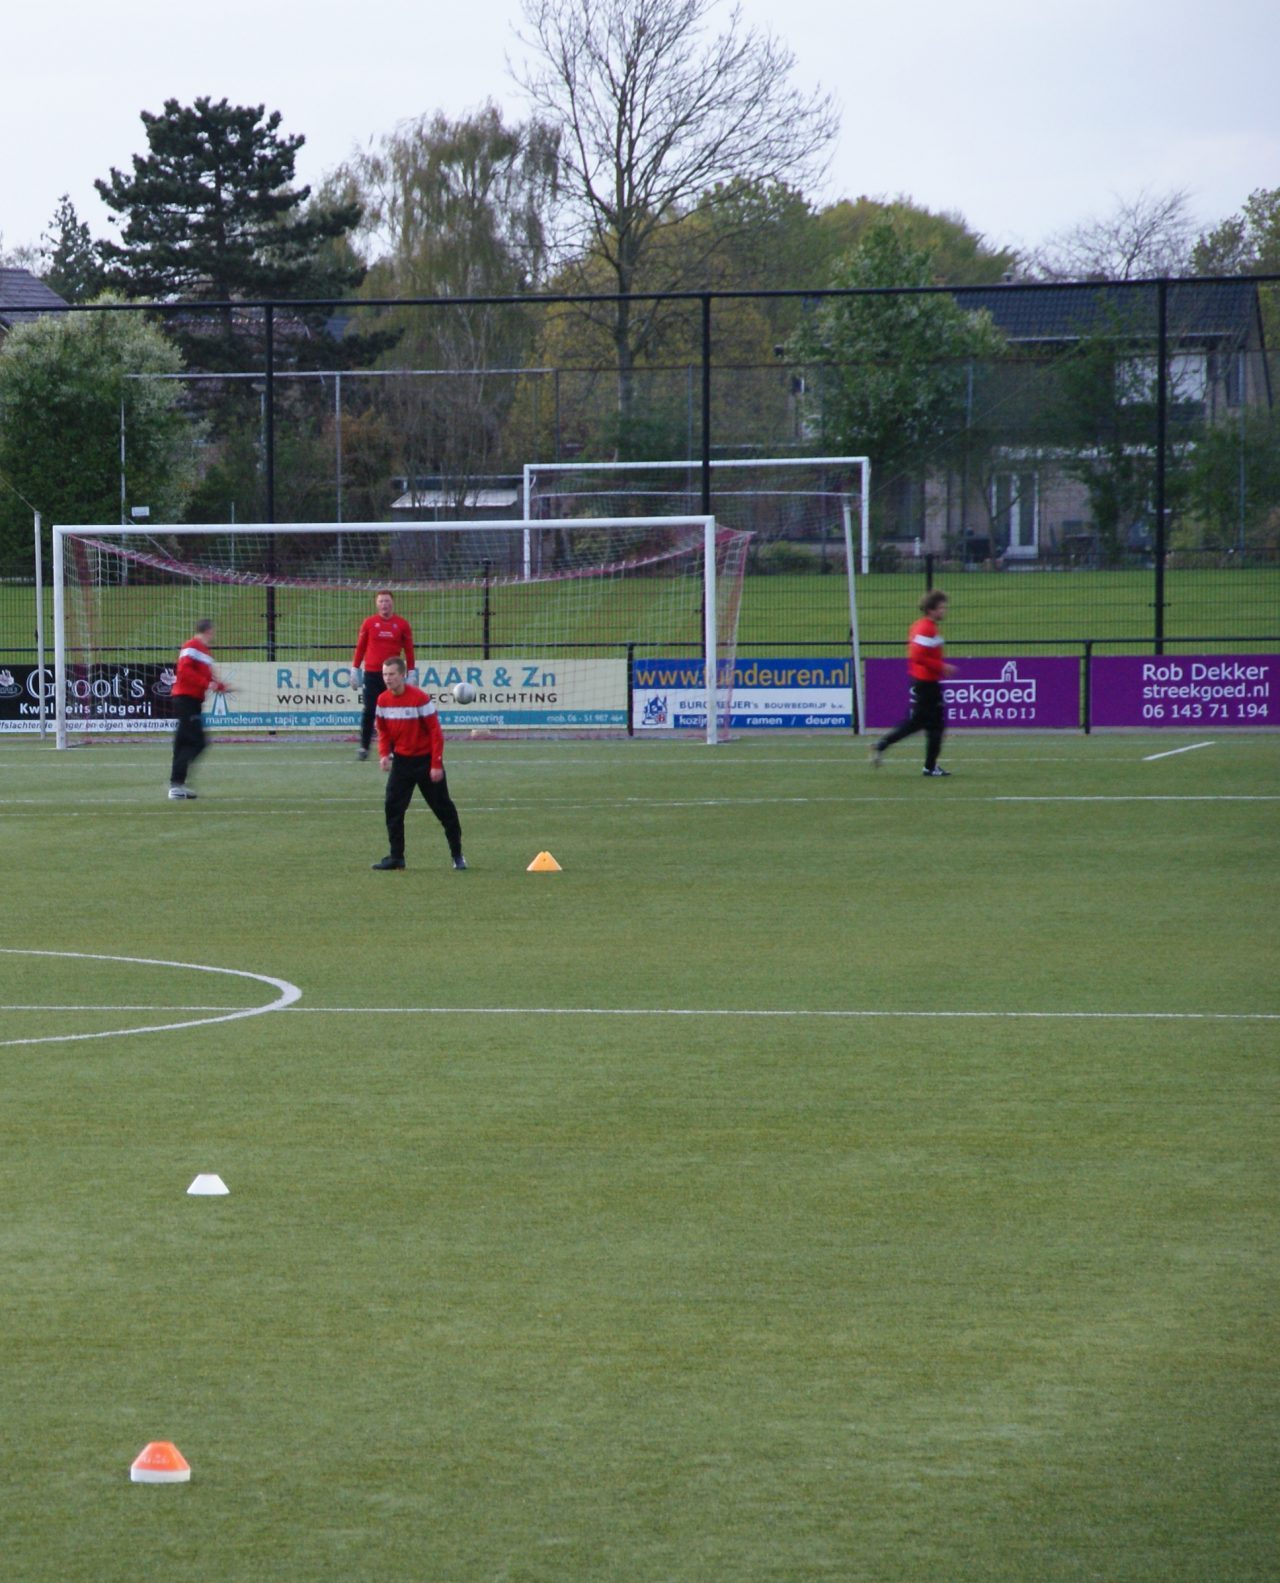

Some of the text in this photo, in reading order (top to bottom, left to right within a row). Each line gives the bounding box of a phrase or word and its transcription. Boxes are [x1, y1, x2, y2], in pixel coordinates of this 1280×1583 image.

[276, 667, 300, 688] R.
[492, 667, 513, 688] &
[522, 667, 557, 687] Zn
[1142, 662, 1269, 681] Rob Dekker
[277, 694, 350, 705] WONING-
[1142, 683, 1269, 702] streekgoed.nl
[97, 701, 152, 717] slagerij
[1142, 703, 1269, 718] 06 143 71 194
[206, 714, 263, 725] marmoleum
[274, 713, 298, 728] tapijt
[453, 714, 505, 727] zonwering
[746, 716, 782, 726] ramen
[805, 715, 846, 726] deuren
